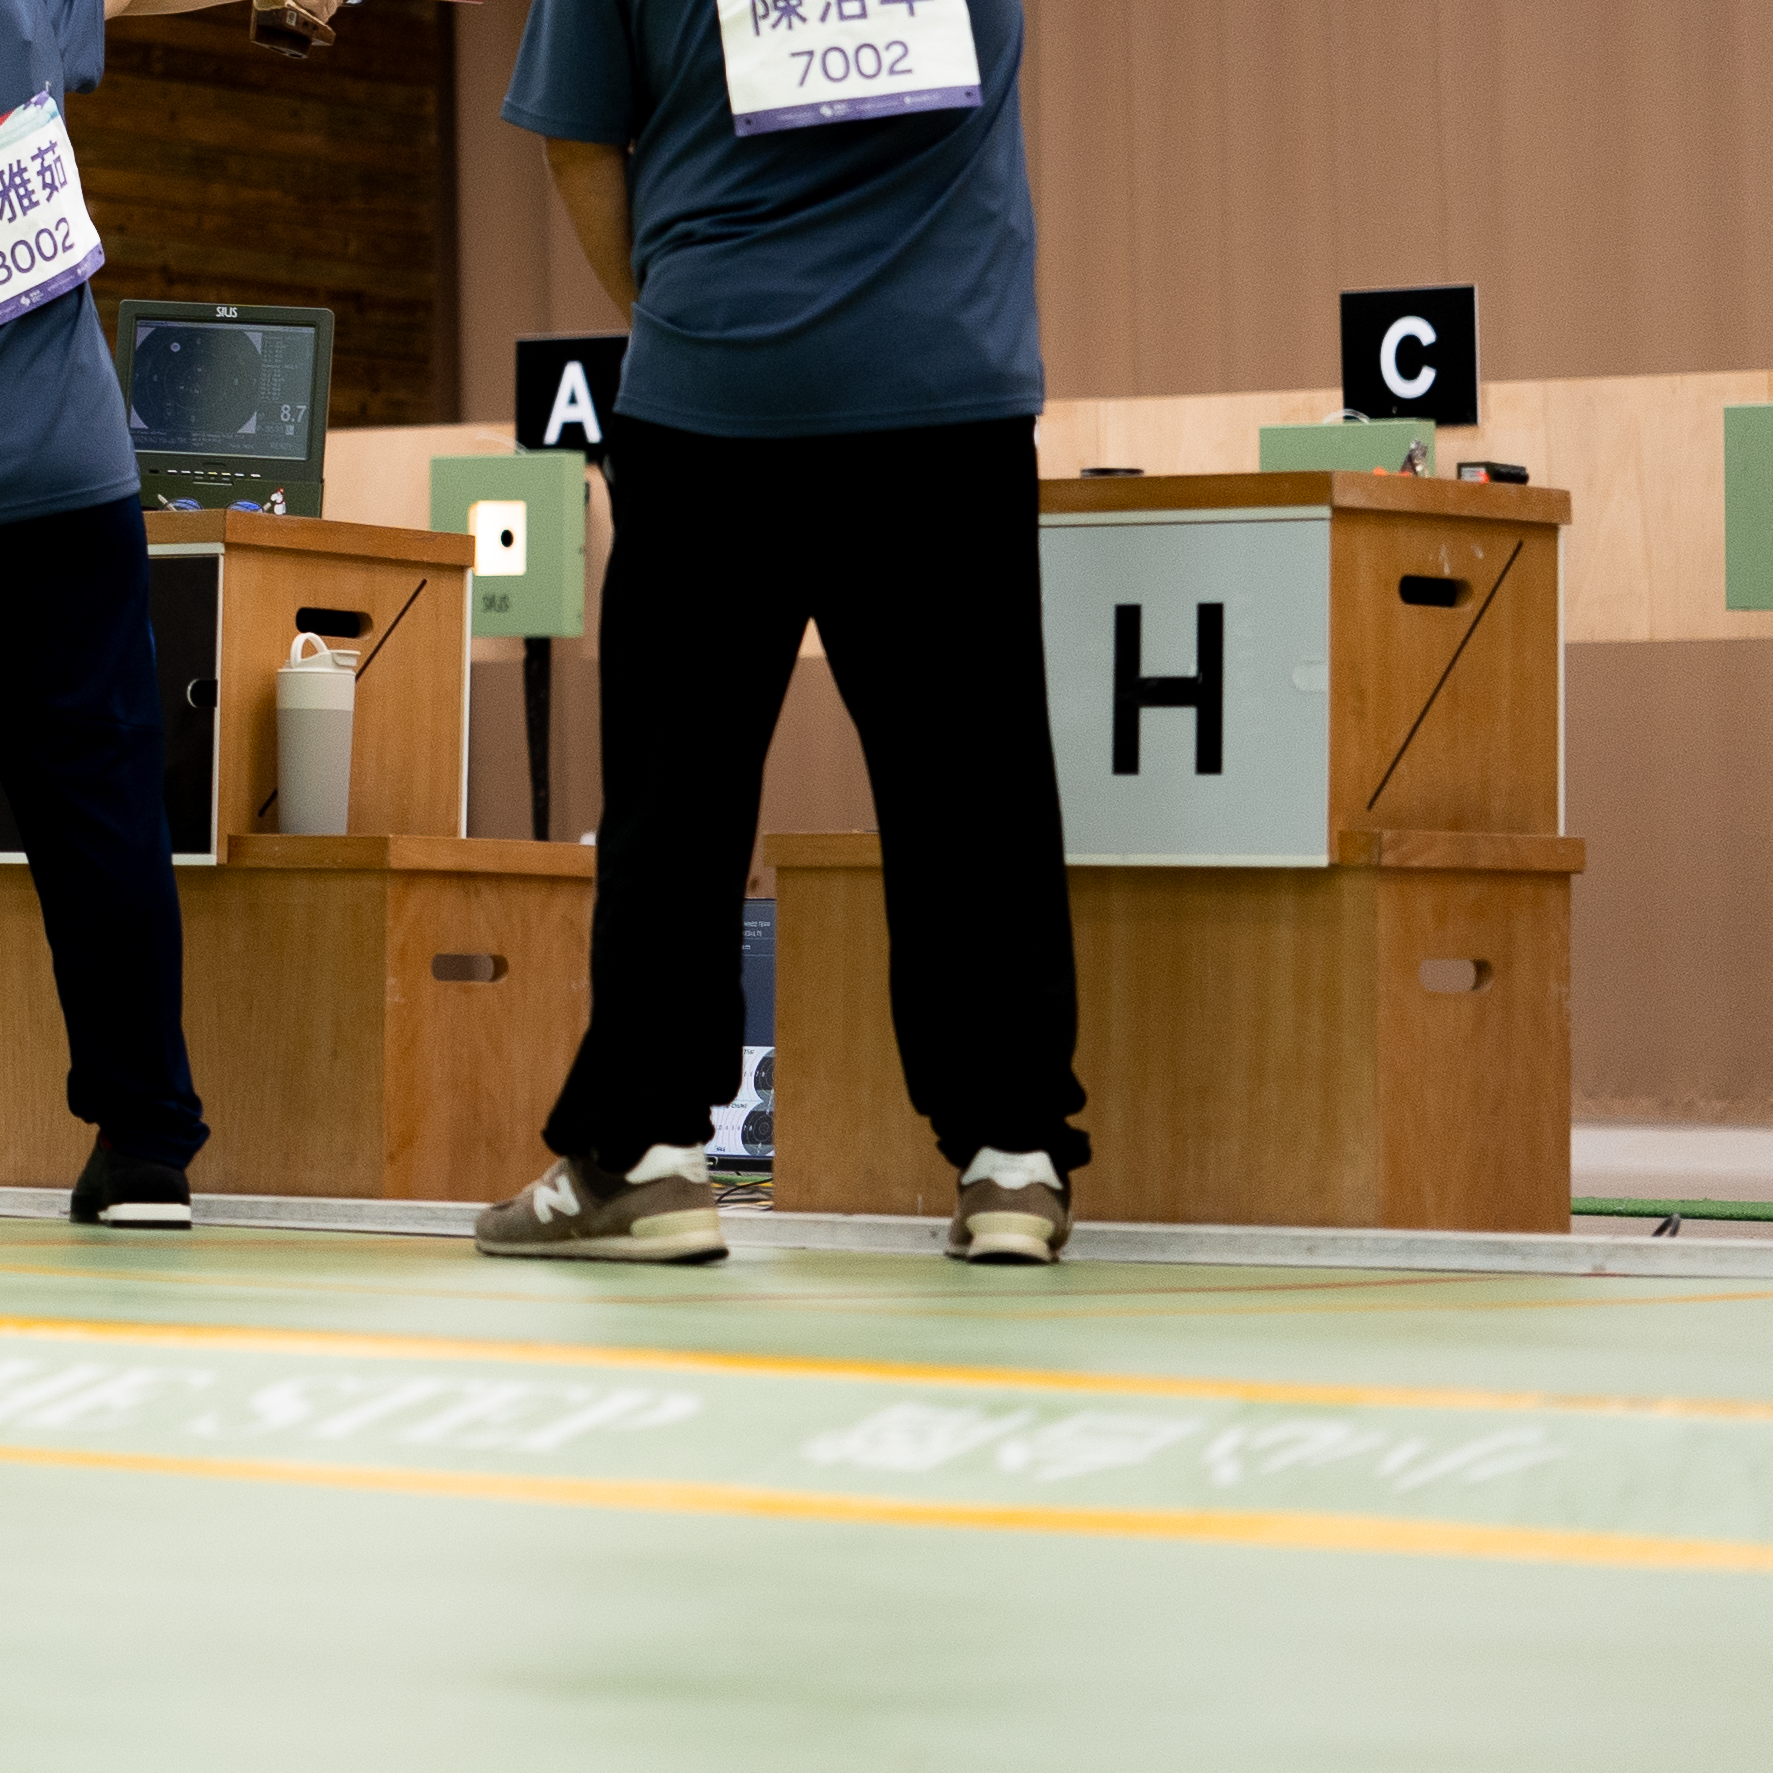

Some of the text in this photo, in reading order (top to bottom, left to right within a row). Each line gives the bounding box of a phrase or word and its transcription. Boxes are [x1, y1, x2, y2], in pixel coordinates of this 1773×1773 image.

[789, 40, 913, 88] 7002
[216, 306, 238, 318] SIUS
[1380, 315, 1438, 399] C
[279, 403, 307, 423] 8.7
[543, 360, 603, 445] A
[1111, 602, 1224, 776] H
[188, 1373, 706, 1454] STEP
